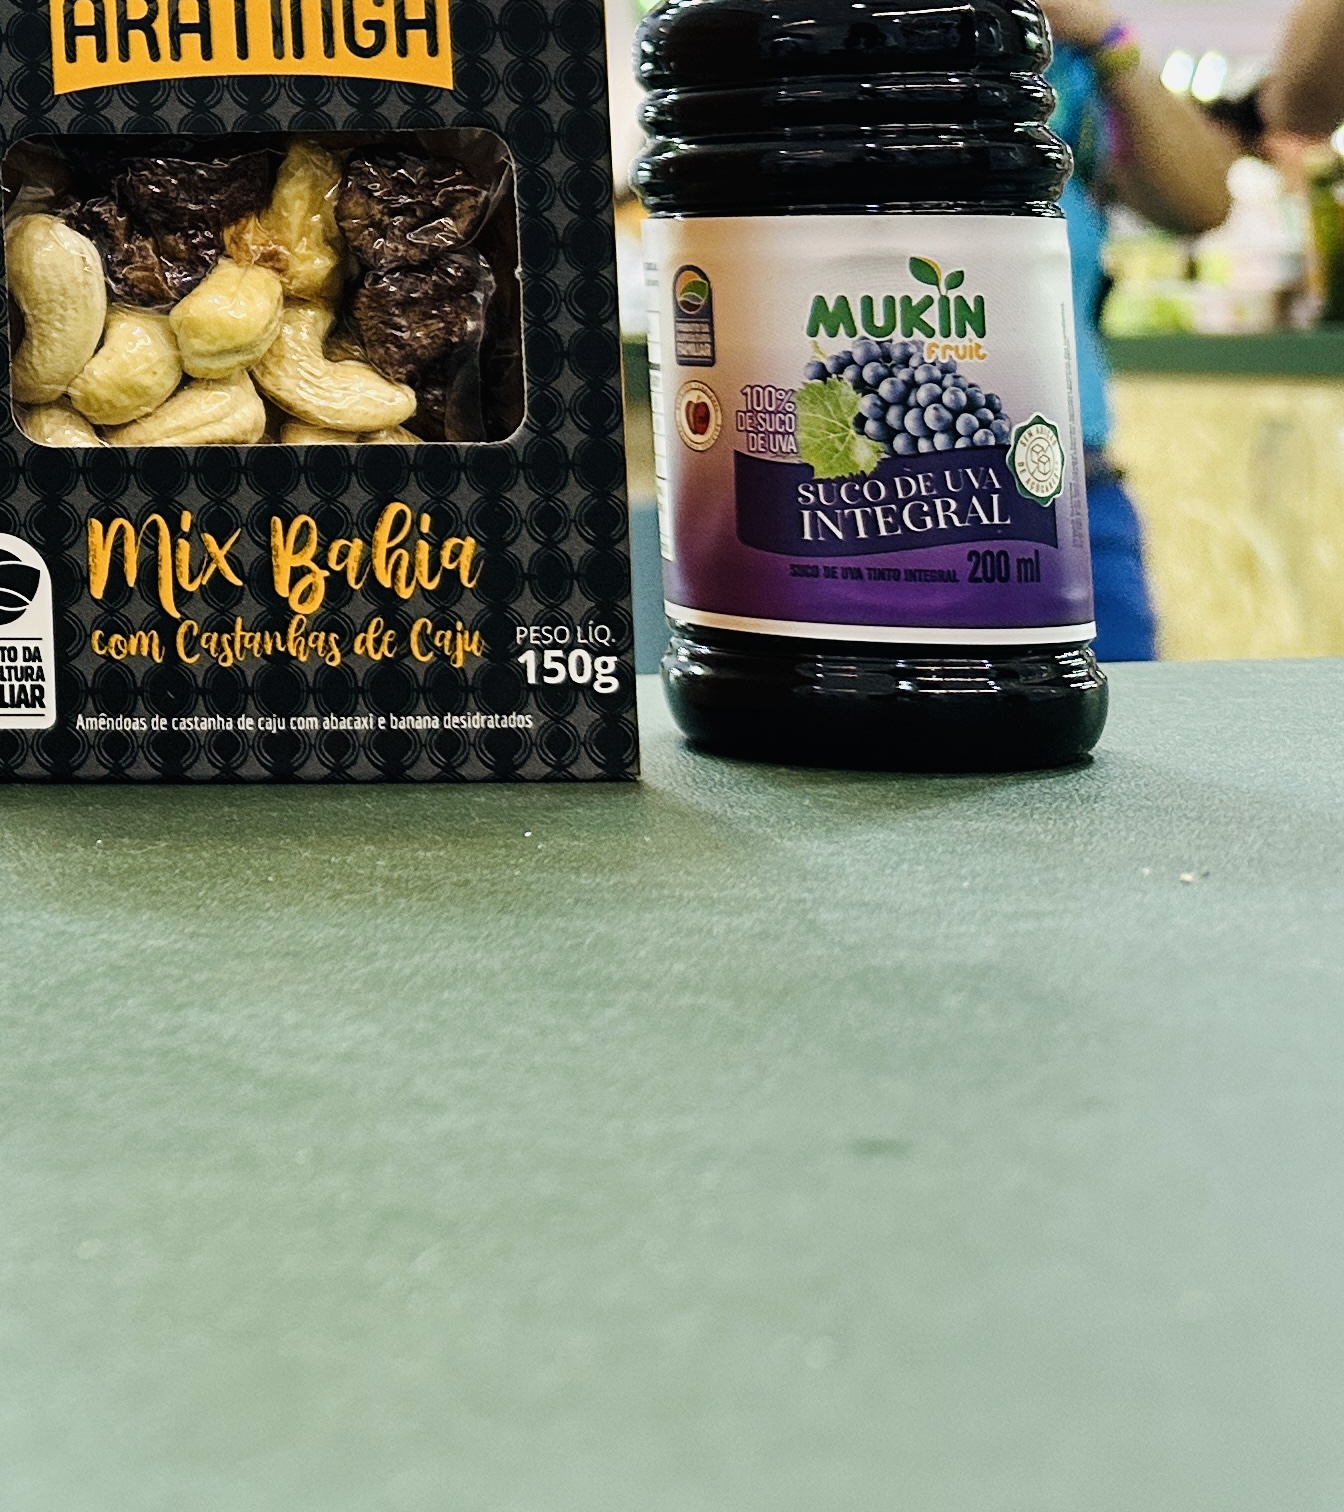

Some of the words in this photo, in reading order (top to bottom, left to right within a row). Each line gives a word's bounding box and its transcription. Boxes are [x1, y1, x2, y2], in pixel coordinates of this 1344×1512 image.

[806, 292, 987, 340] MUKIN
[741, 384, 796, 413] 100%
[736, 412, 755, 432] DE
[757, 412, 796, 433] SUCO
[747, 432, 767, 453] DE
[769, 432, 798, 454] UVA
[797, 477, 889, 508] SUCO
[893, 470, 935, 500] DE
[945, 467, 1004, 493] UVA
[801, 492, 1012, 541] INTEGRAL
[87, 510, 245, 619] Mix
[269, 501, 486, 615] Bahia
[865, 566, 901, 583] TINTO
[903, 568, 961, 585] INTEGRAL
[967, 548, 1012, 585] 200
[1016, 548, 1042, 584] ml
[90, 629, 166, 664] com
[174, 614, 343, 668] Castanhas
[352, 614, 400, 660] de
[410, 617, 487, 668] Caju
[515, 625, 570, 646] PESO
[576, 619, 616, 647] LÍQ.
[21, 645, 42, 663] DA
[516, 647, 620, 694] 150g
[75, 712, 148, 732] Amêndoas
[150, 714, 168, 732] de
[171, 714, 234, 732] castanha
[236, 714, 255, 732] de
[257, 714, 287, 735] caju
[289, 715, 320, 731] com
[321, 712, 375, 731] abacaxi
[377, 716, 386, 730] e
[389, 712, 442, 730] banana
[443, 710, 534, 730] desidratados
